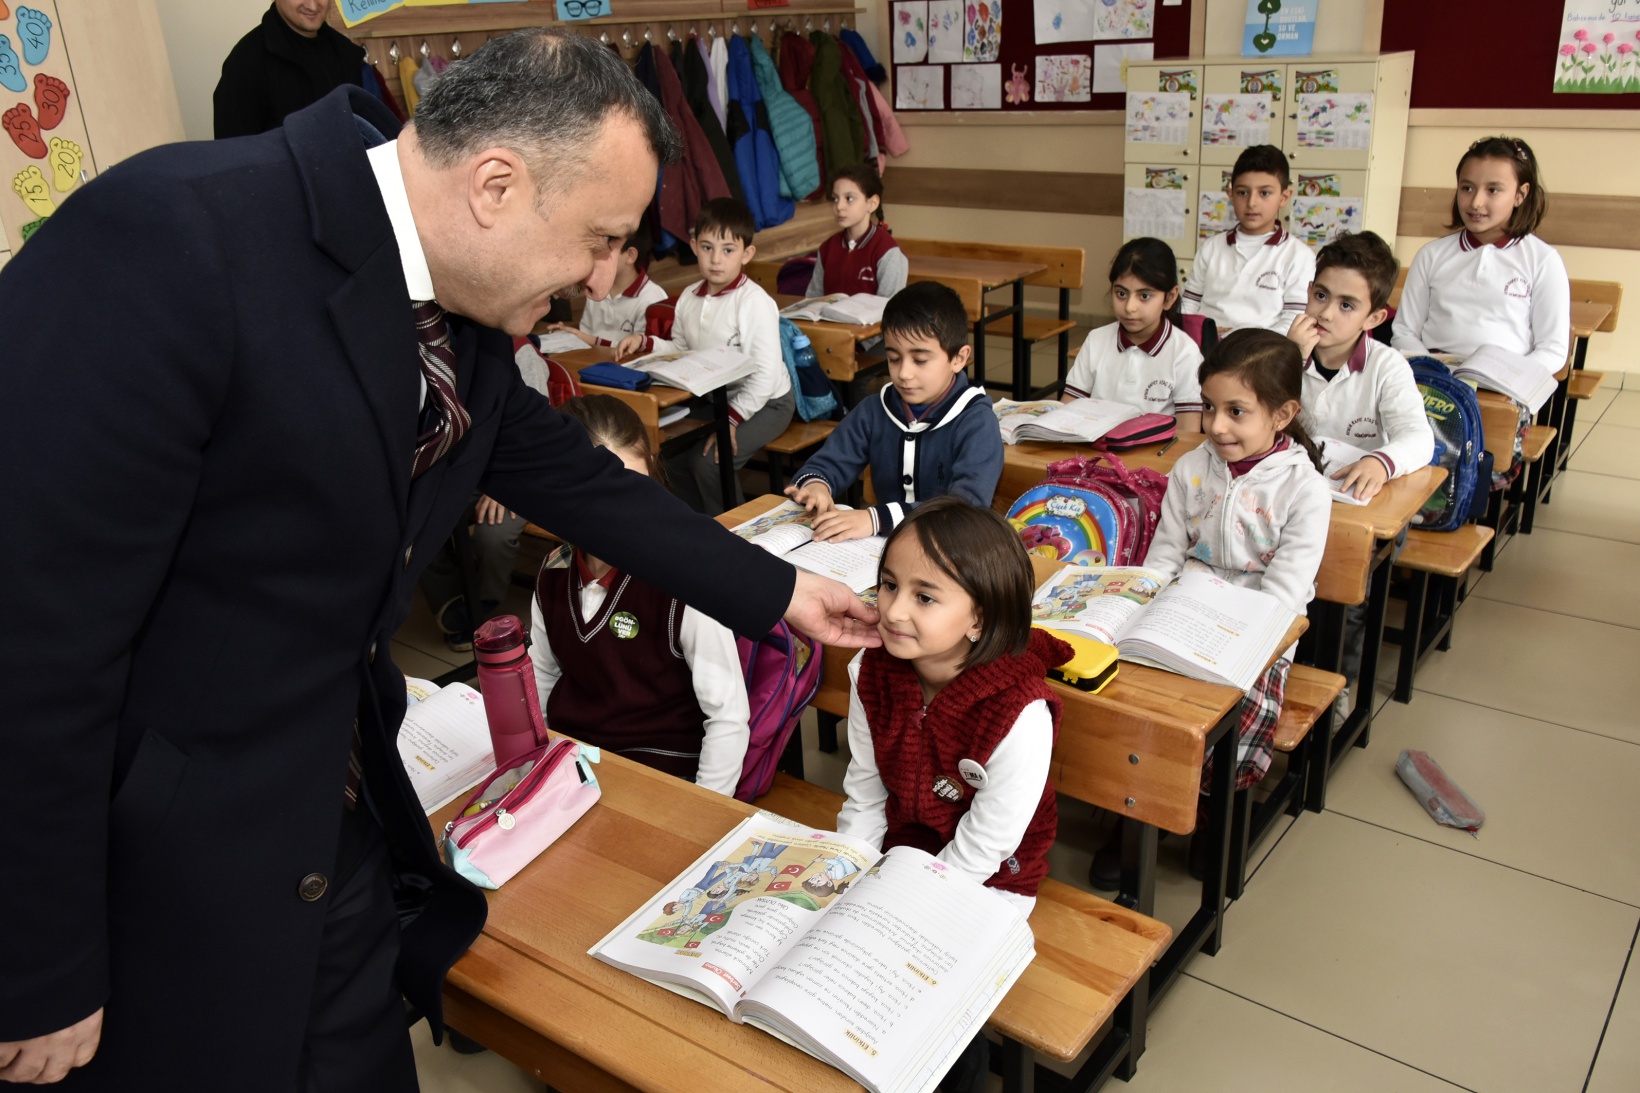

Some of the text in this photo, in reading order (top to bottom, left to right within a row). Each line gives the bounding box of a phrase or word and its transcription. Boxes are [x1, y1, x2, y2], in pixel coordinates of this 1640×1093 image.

[26, 22, 44, 50] 40
[1276, 32, 1298, 40] ORMAN
[1278, 24, 1296, 32] SU VE
[0, 53, 17, 76] 35
[42, 89, 60, 116] 30
[12, 120, 39, 144] 25
[58, 151, 76, 179] 20
[31, 184, 49, 203] 15
[846, 913, 859, 922] Hoca
[867, 909, 890, 924] hareketle
[860, 919, 886, 938] Nasreddin
[758, 945, 771, 957] Türk
[917, 933, 942, 953] hakkındaki
[751, 959, 759, 969] Ne
[861, 961, 874, 971] yere
[872, 957, 887, 969] tekrar
[904, 961, 930, 981] Etkinlik
[910, 953, 938, 975] Defterinize
[704, 962, 741, 990] Serbest Okuma
[804, 975, 823, 988] zaman
[822, 974, 836, 984] neler
[840, 972, 859, 989] bakınca
[852, 967, 874, 986] kuyudan
[803, 987, 817, 998] göre
[836, 983, 856, 1000] bakınca
[860, 986, 879, 1002] kuyuya
[815, 996, 833, 1010] metne
[851, 1008, 880, 1031] Nasreddin
[843, 1028, 878, 1057] 5. Etkinlik
[853, 1024, 880, 1045] Aşağıdaki
